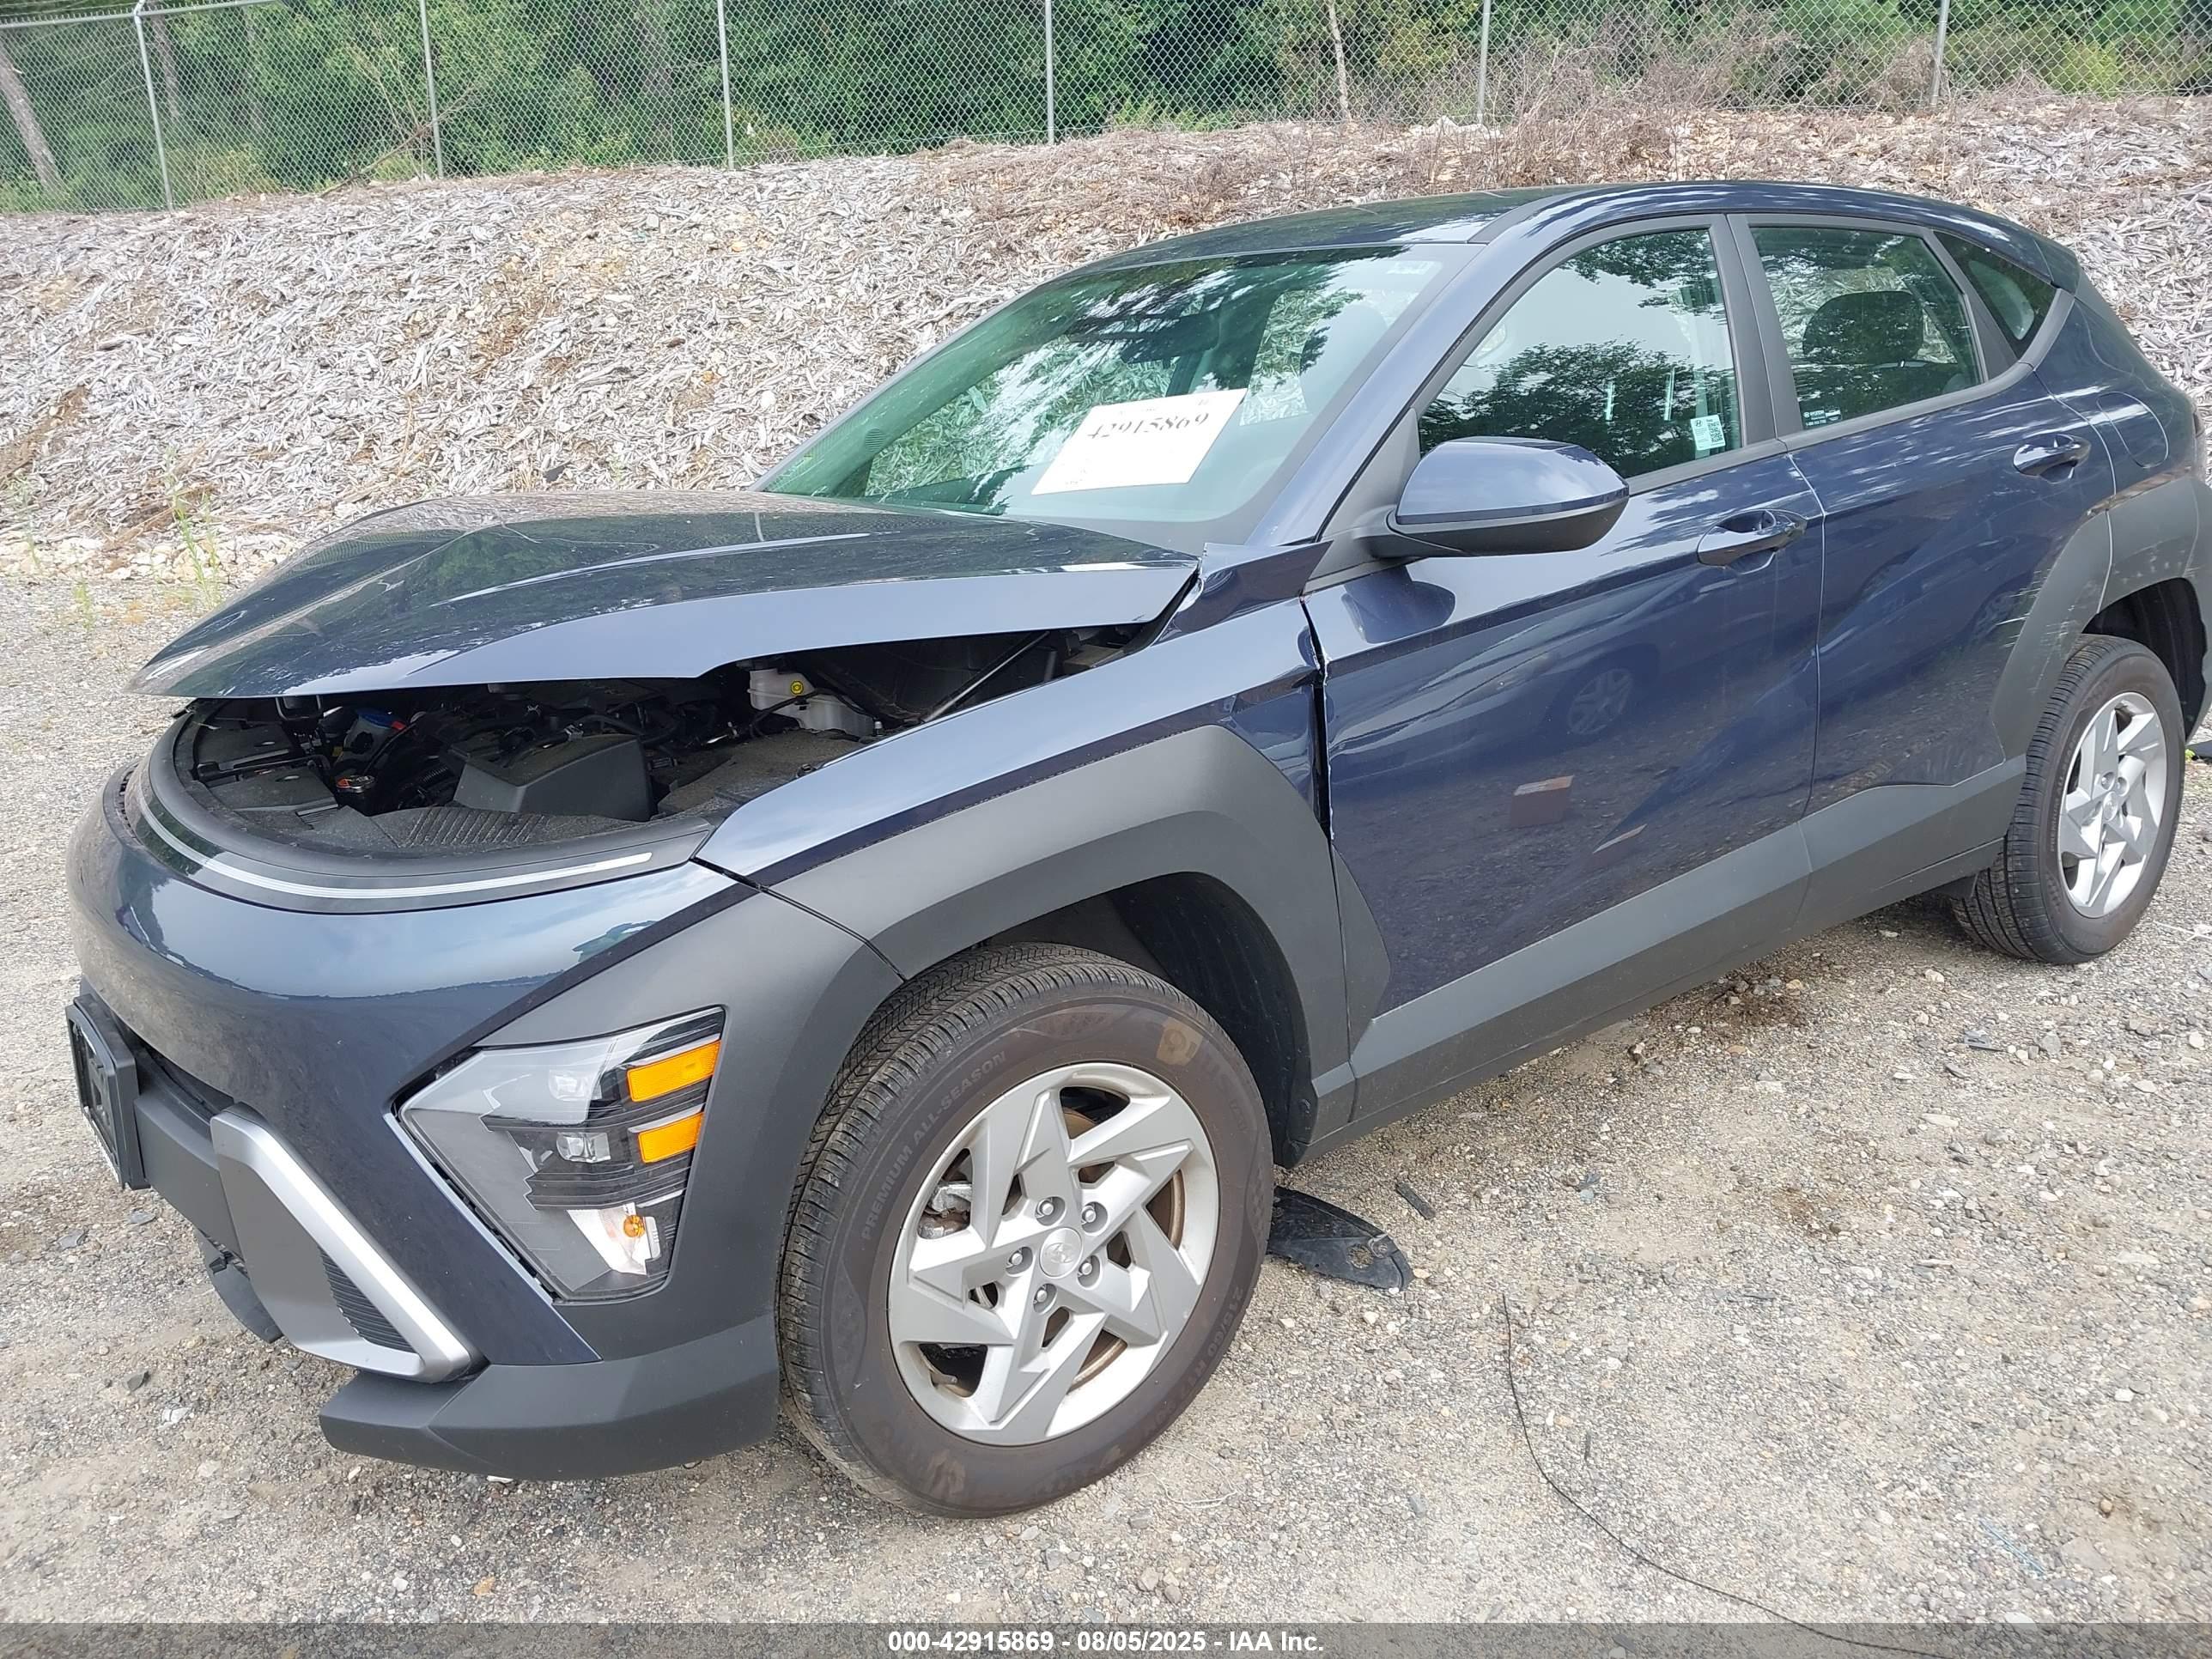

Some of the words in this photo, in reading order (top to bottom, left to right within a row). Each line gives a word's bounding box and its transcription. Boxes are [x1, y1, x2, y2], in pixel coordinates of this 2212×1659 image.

[861, 1145, 915, 1240] PREMIUM
[913, 1049, 1006, 1144] ALL-SEASON
[1206, 1285, 1244, 1358] 215/60
